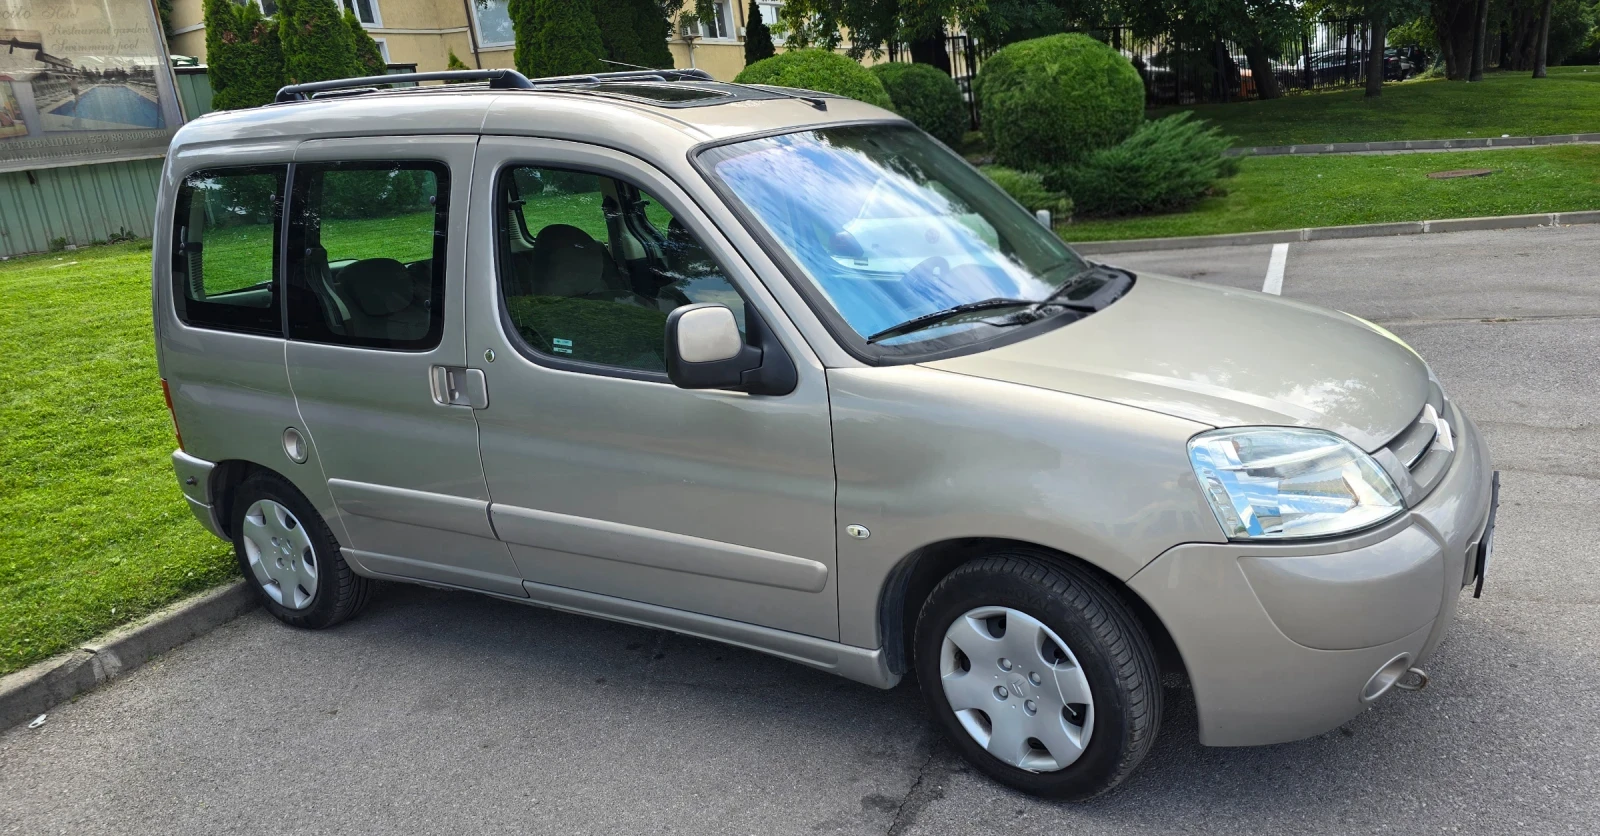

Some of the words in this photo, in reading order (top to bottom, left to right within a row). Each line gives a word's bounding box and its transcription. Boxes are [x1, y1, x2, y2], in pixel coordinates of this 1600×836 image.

[46, 22, 111, 35] Restaurant
[52, 39, 114, 54] Swimming
[116, 38, 139, 54] pool
[111, 132, 124, 142] 88
